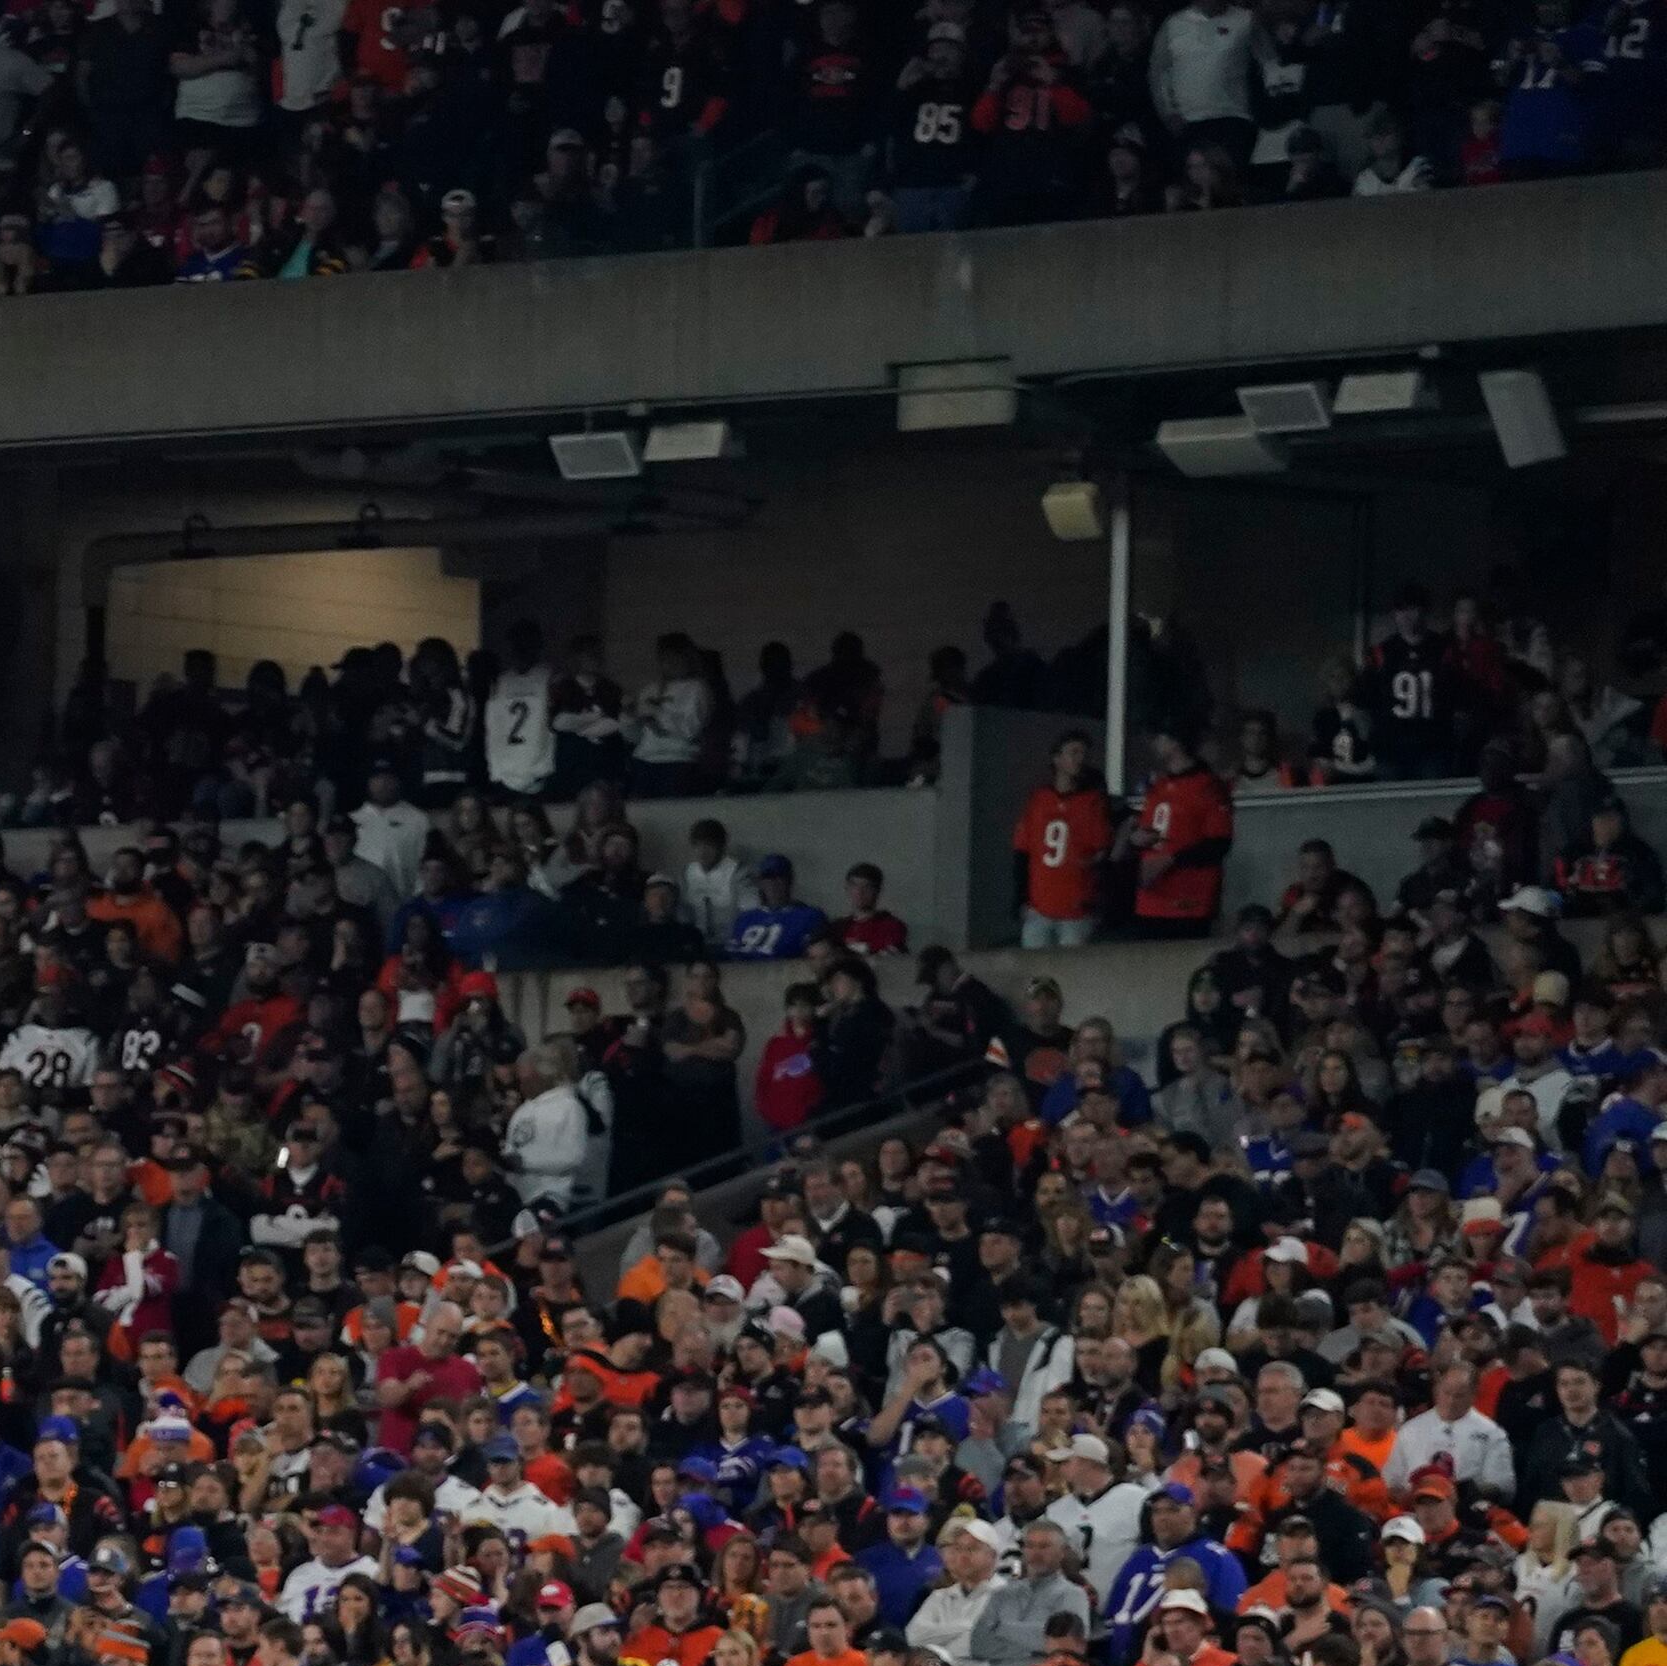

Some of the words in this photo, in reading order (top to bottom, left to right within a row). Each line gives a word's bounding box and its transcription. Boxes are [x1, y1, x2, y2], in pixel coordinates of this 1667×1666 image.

[663, 67, 681, 107] 9
[914, 103, 962, 144] 85
[1393, 672, 1431, 718] 91
[509, 703, 525, 743] 2
[1044, 821, 1066, 866] 9
[28, 1051, 70, 1087] 28
